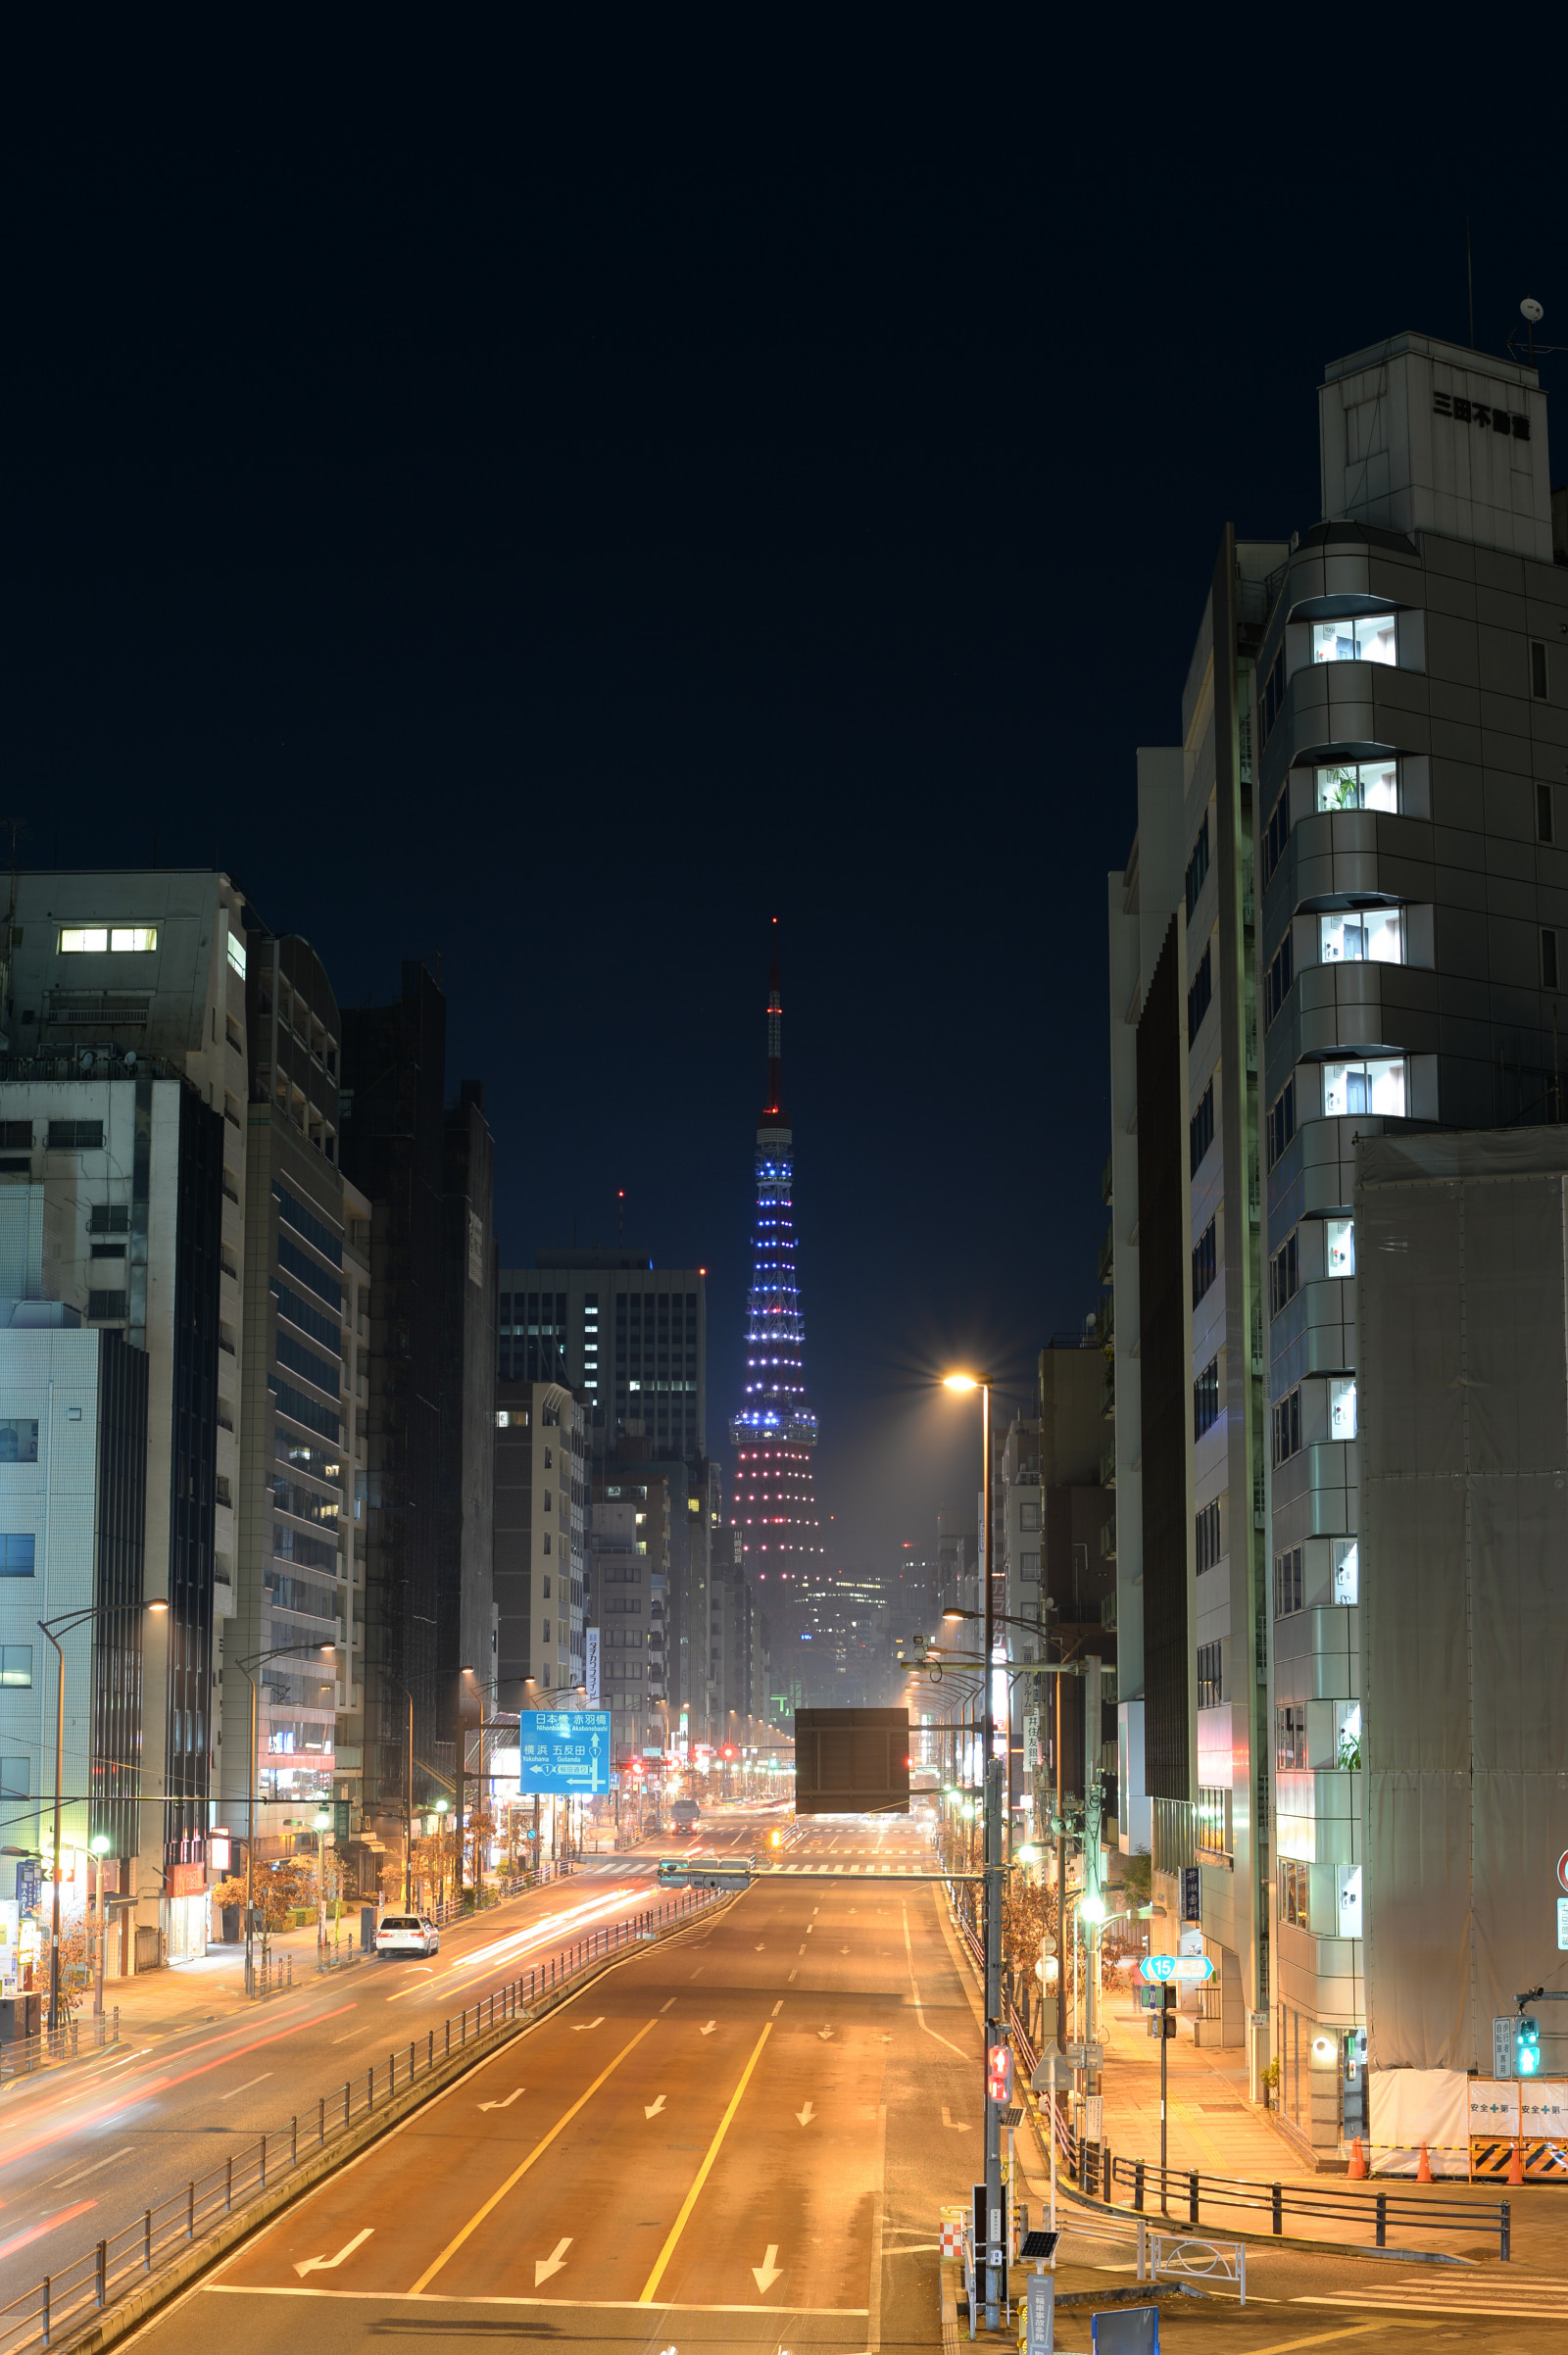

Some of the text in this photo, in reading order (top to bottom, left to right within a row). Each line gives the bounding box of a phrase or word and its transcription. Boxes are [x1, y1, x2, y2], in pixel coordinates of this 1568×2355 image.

[1433, 391, 1531, 441] 三田不動産
[1023, 1646, 1033, 1708] 三田サージルーム
[536, 1713, 607, 1725] 日本橋 赤羽橋
[524, 1744, 585, 1756] 横浜 五反田
[1154, 1960, 1171, 1976] 15
[1470, 2103, 1519, 2114] 安全 第一
[1521, 2105, 1540, 2115] 安全
